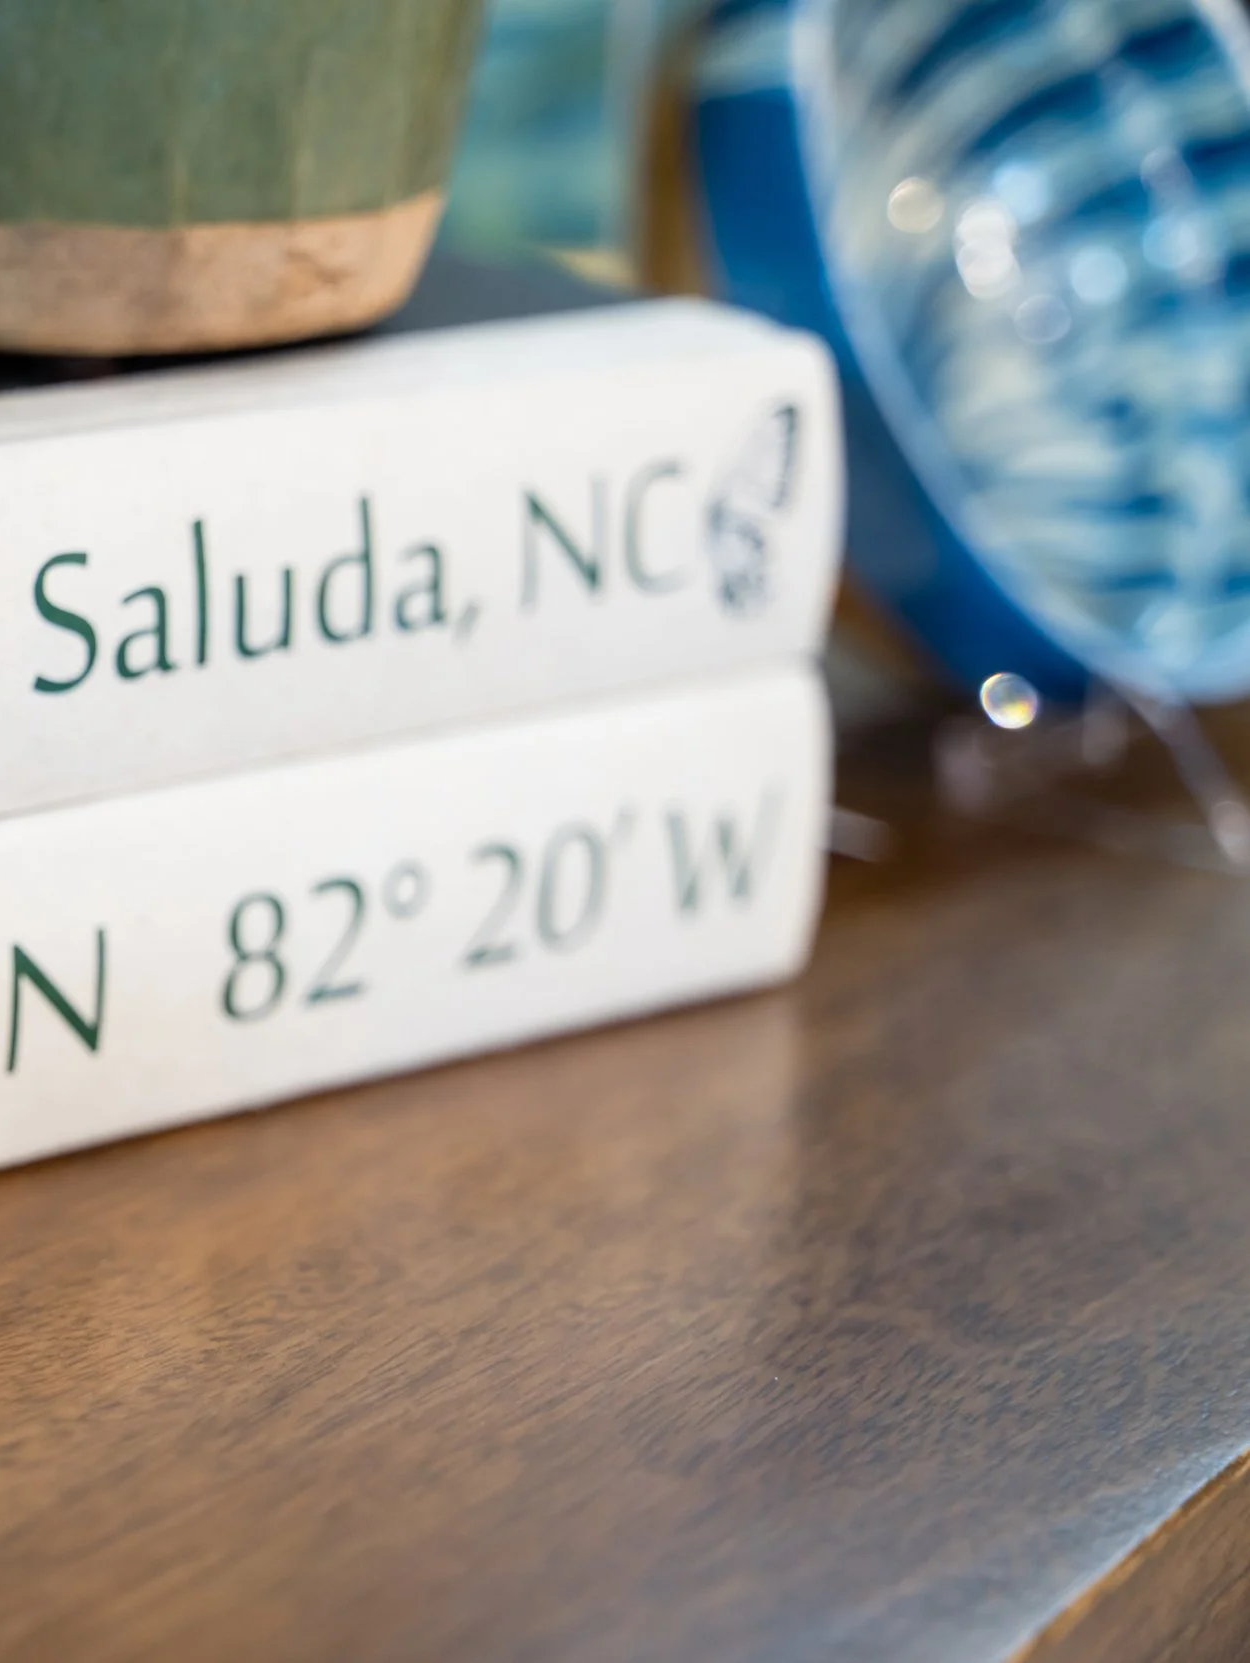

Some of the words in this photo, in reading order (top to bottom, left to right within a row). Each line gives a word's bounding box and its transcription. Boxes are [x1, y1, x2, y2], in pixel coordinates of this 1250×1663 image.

[32, 494, 481, 694] Saluda,
[519, 459, 688, 612] NC
[5, 927, 107, 1075] N
[218, 859, 432, 1024] 82°
[661, 780, 787, 916] W
